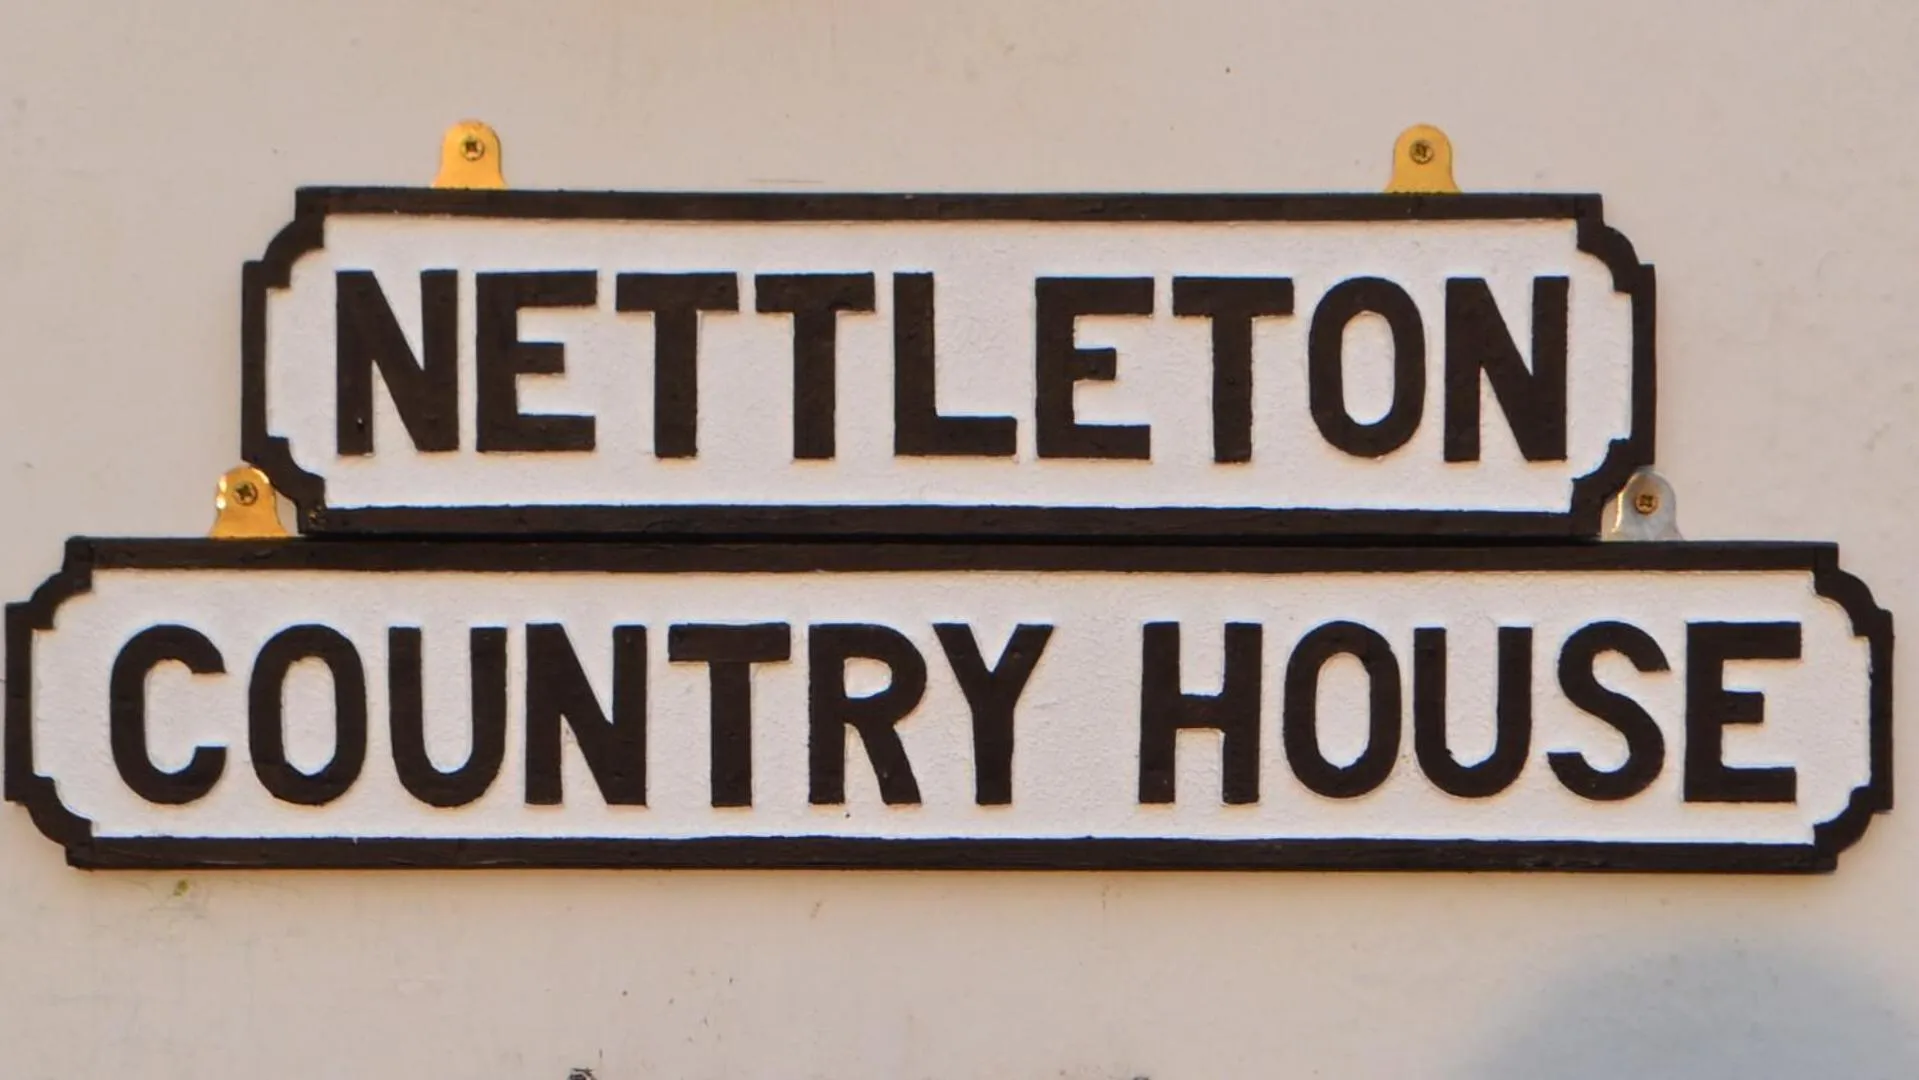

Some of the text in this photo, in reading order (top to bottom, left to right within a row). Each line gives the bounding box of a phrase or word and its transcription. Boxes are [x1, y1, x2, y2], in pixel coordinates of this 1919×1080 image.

[336, 269, 1569, 464] NETTLETON
[110, 621, 1802, 808] COUNTRY HOUSE
